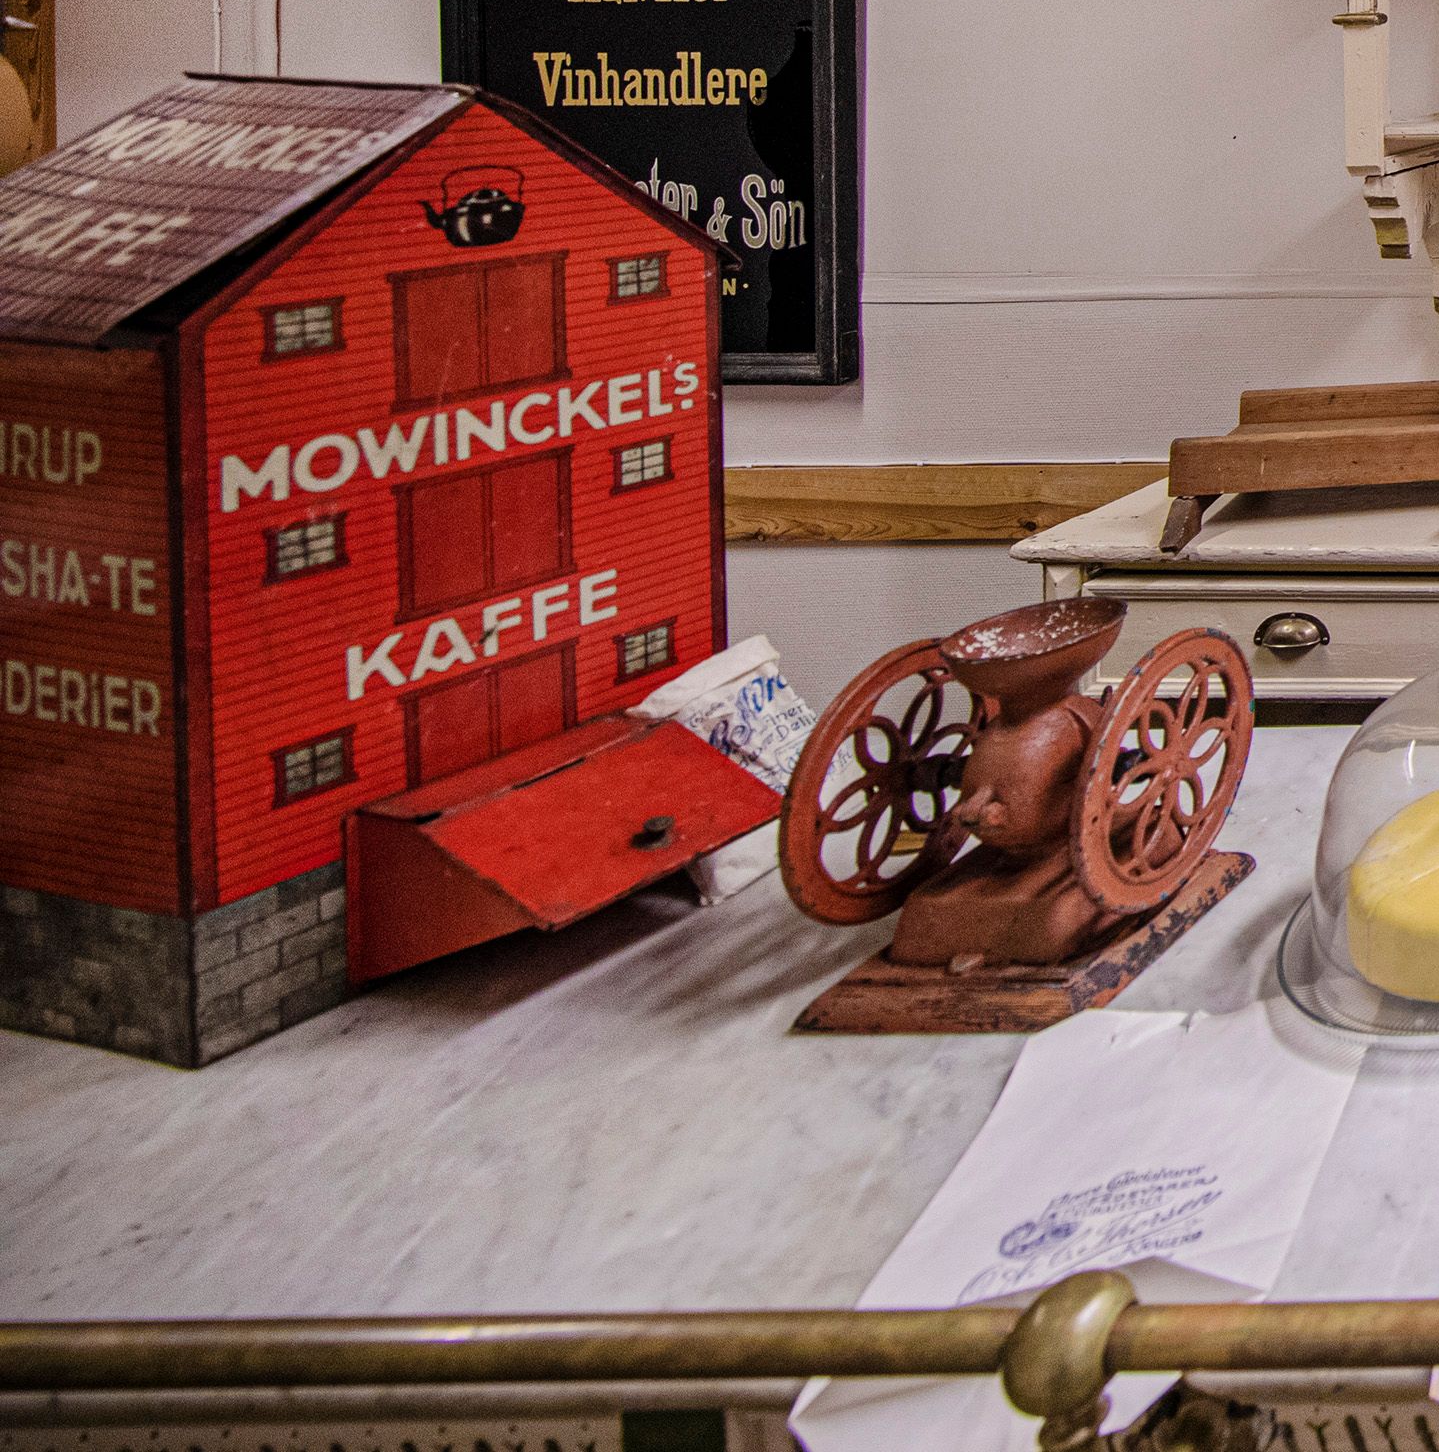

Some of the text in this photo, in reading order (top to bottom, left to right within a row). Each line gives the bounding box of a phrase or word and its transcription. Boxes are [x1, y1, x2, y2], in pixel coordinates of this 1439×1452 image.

[533, 51, 768, 107] Vinhandlere
[706, 196, 733, 243] &
[741, 173, 807, 249] Sön
[346, 569, 620, 702] KAFFE
